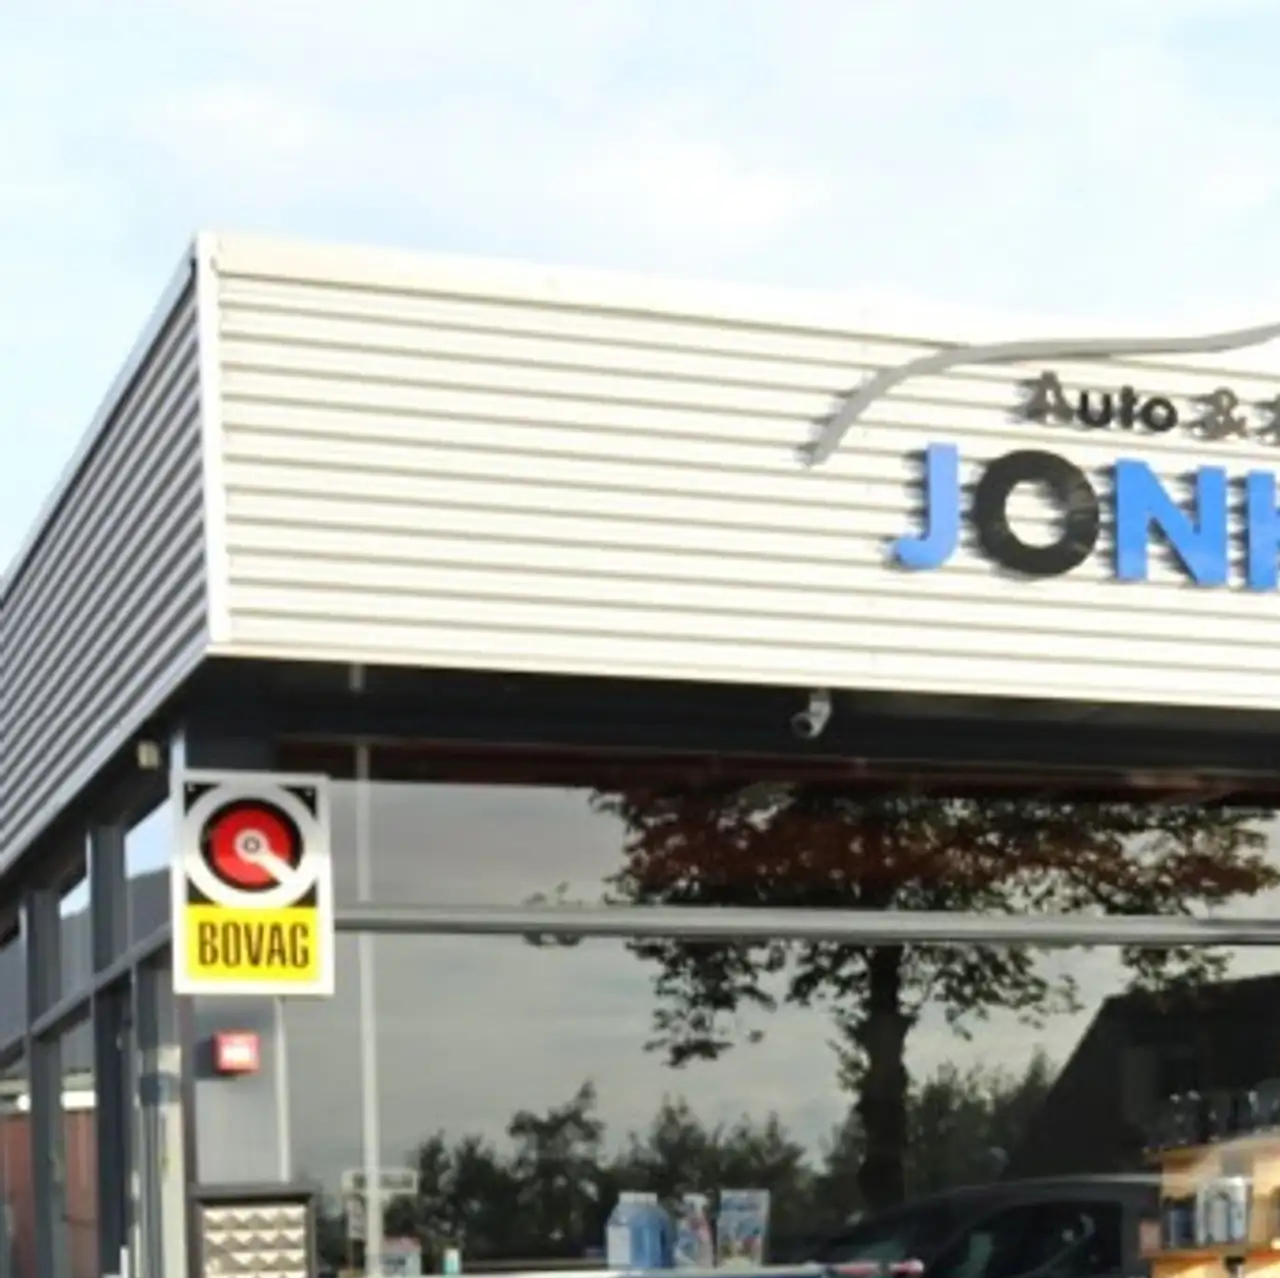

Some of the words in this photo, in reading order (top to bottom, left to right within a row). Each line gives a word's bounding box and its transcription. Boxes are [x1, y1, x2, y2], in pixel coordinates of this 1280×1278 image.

[1026, 371, 1178, 432] Auto
[1199, 387, 1248, 440] &
[198, 920, 310, 969] BOVAG
